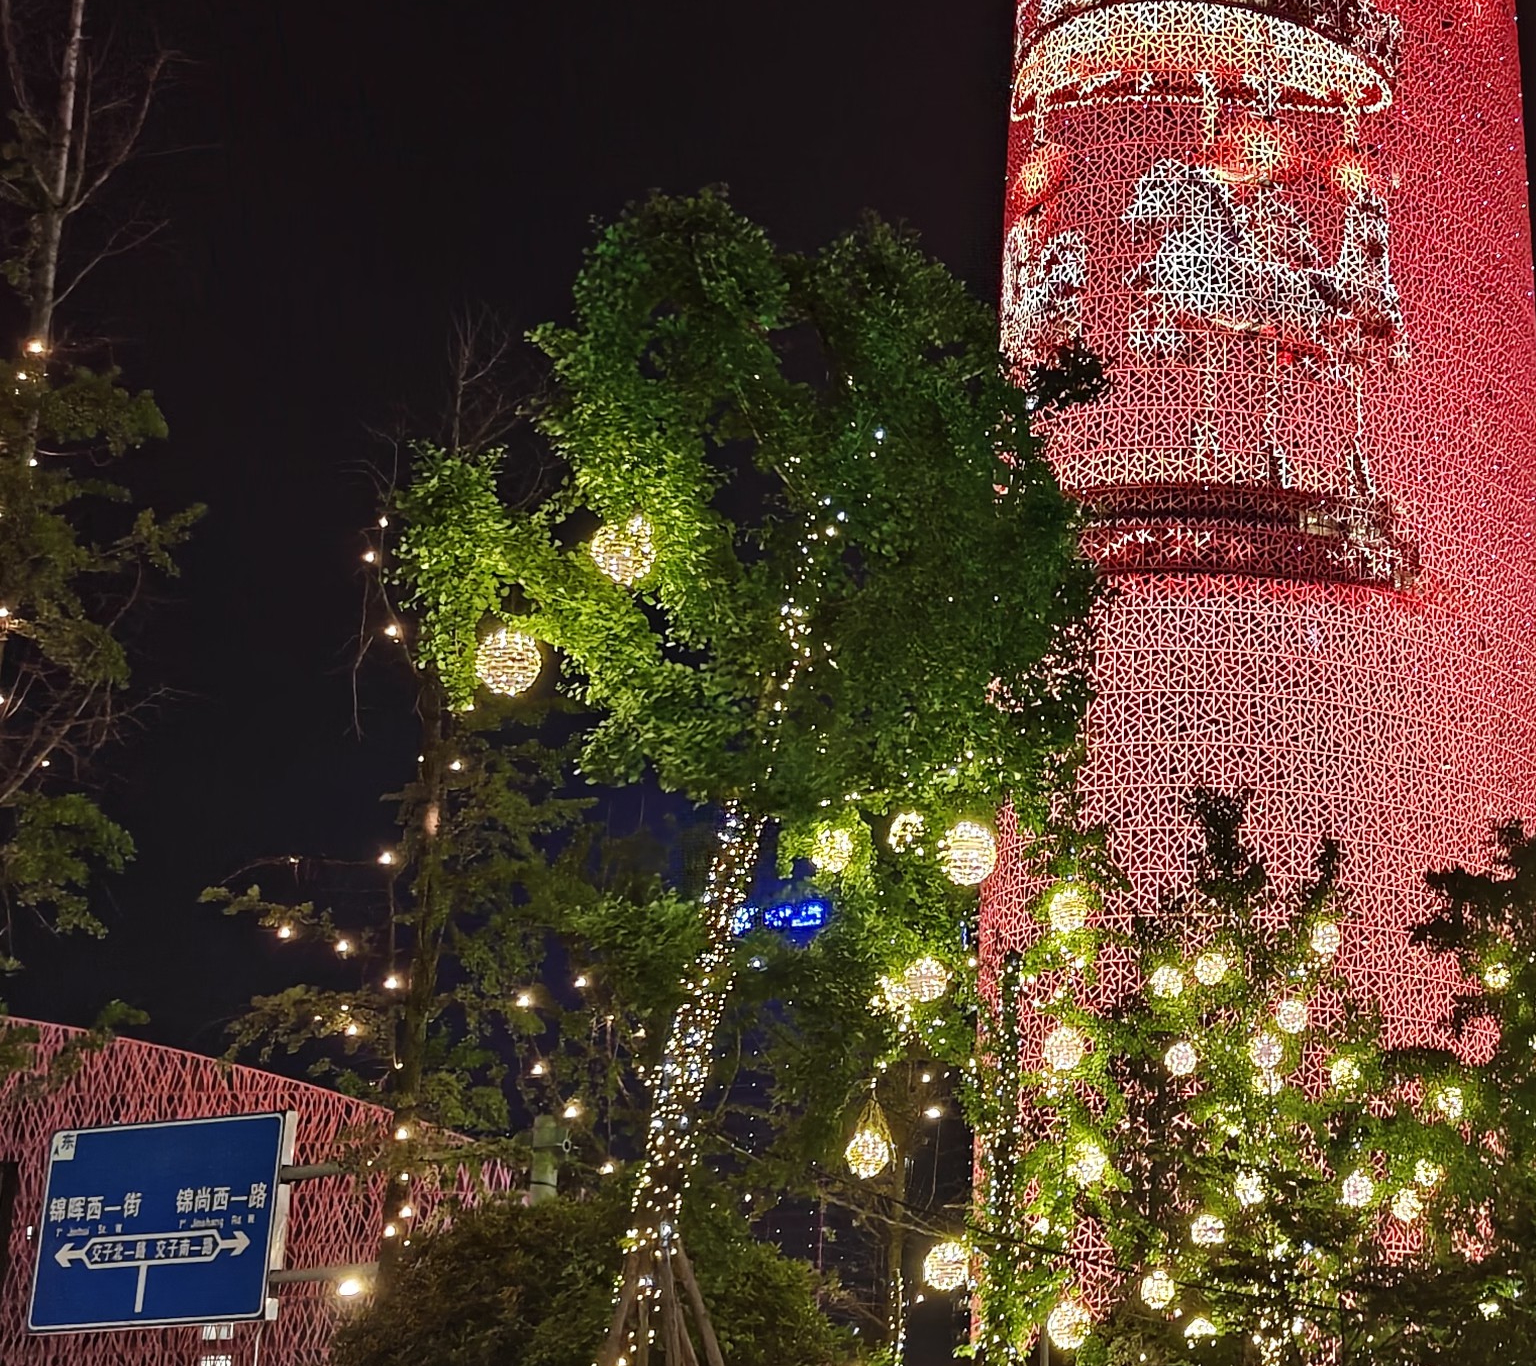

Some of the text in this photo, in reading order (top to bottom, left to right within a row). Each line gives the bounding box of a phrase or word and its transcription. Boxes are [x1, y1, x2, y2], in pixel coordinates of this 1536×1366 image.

[61, 1133, 75, 1150] 东
[49, 1191, 143, 1223] 锦晖西一街
[176, 1181, 268, 1214] 锦尚西一路
